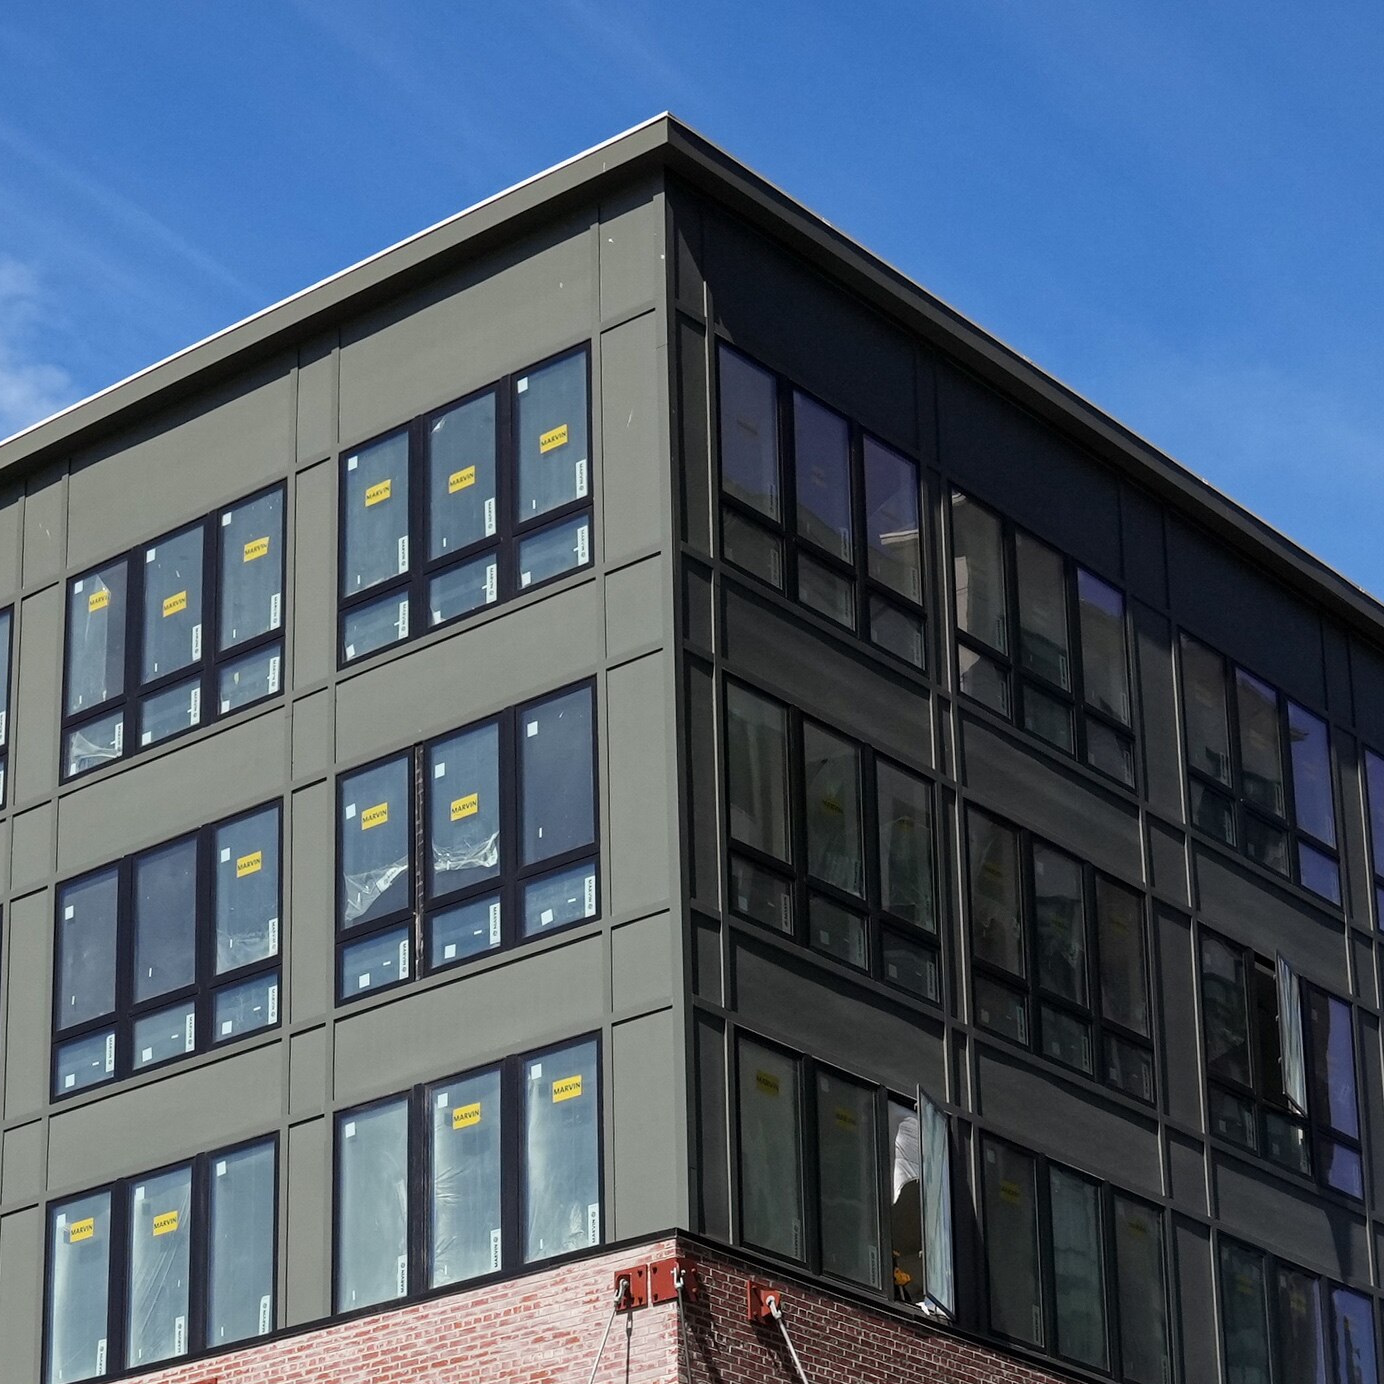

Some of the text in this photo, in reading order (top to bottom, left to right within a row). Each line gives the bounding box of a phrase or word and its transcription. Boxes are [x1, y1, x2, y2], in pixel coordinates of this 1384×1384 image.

[541, 432, 567, 445] MARVIN
[450, 473, 473, 486] MARVIN
[366, 487, 390, 500] MARVIN
[245, 544, 267, 555] MARVIN
[164, 597, 184, 610] MARVIN
[452, 800, 477, 813] MARVIN
[362, 810, 387, 823] MARVIN
[237, 857, 261, 870] MARVIN
[553, 1081, 581, 1095] MARVIN
[453, 1109, 478, 1122] MARVIN
[154, 1216, 177, 1229] MARVIN
[71, 1224, 92, 1236] MARVIN
